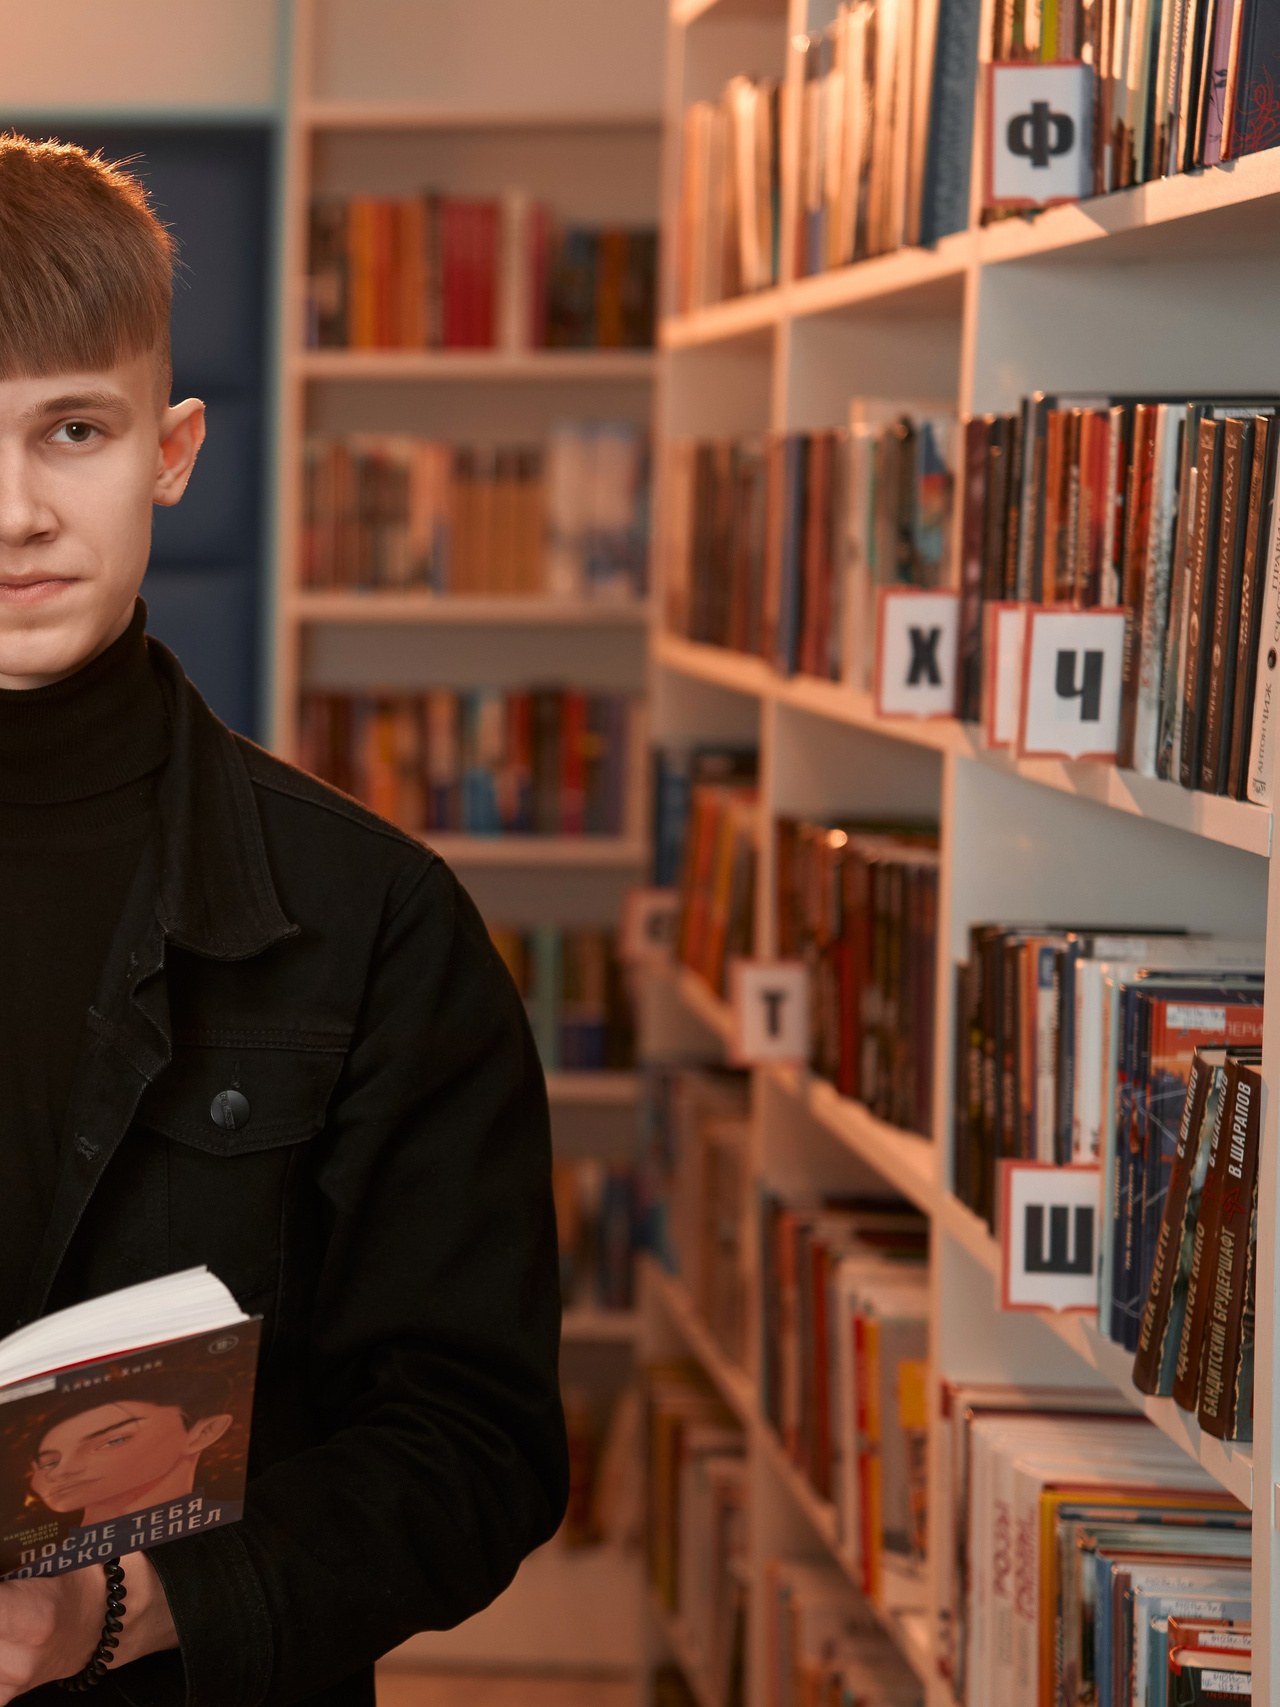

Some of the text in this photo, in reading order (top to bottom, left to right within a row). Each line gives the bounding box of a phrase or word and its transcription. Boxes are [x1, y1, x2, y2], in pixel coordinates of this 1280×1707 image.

[1006, 101, 1075, 168] Ф
[1222, 455, 1235, 544] СТРАХА
[905, 625, 942, 687] Х
[1056, 650, 1105, 723] Ч
[1256, 682, 1272, 774] АНТОН ЧИЖ
[760, 989, 786, 1041] Т
[1180, 1067, 1199, 1142] ШАРАПОВ
[1024, 1204, 1095, 1275] Ш
[1151, 1222, 1170, 1297] СМЕРТИ
[1176, 1221, 1205, 1383] ЯДОВИТОЕ КИНО
[1203, 1226, 1236, 1418] БАНДИТСКИЙ БРУДЕРШАФТ
[61, 1374, 112, 1394] Алекс
[121, 1359, 164, 1377] Хилл
[21, 1497, 202, 1565] ПОСЛЕ ТЕБЯ
[130, 1508, 221, 1548] ПЕПЕЛ
